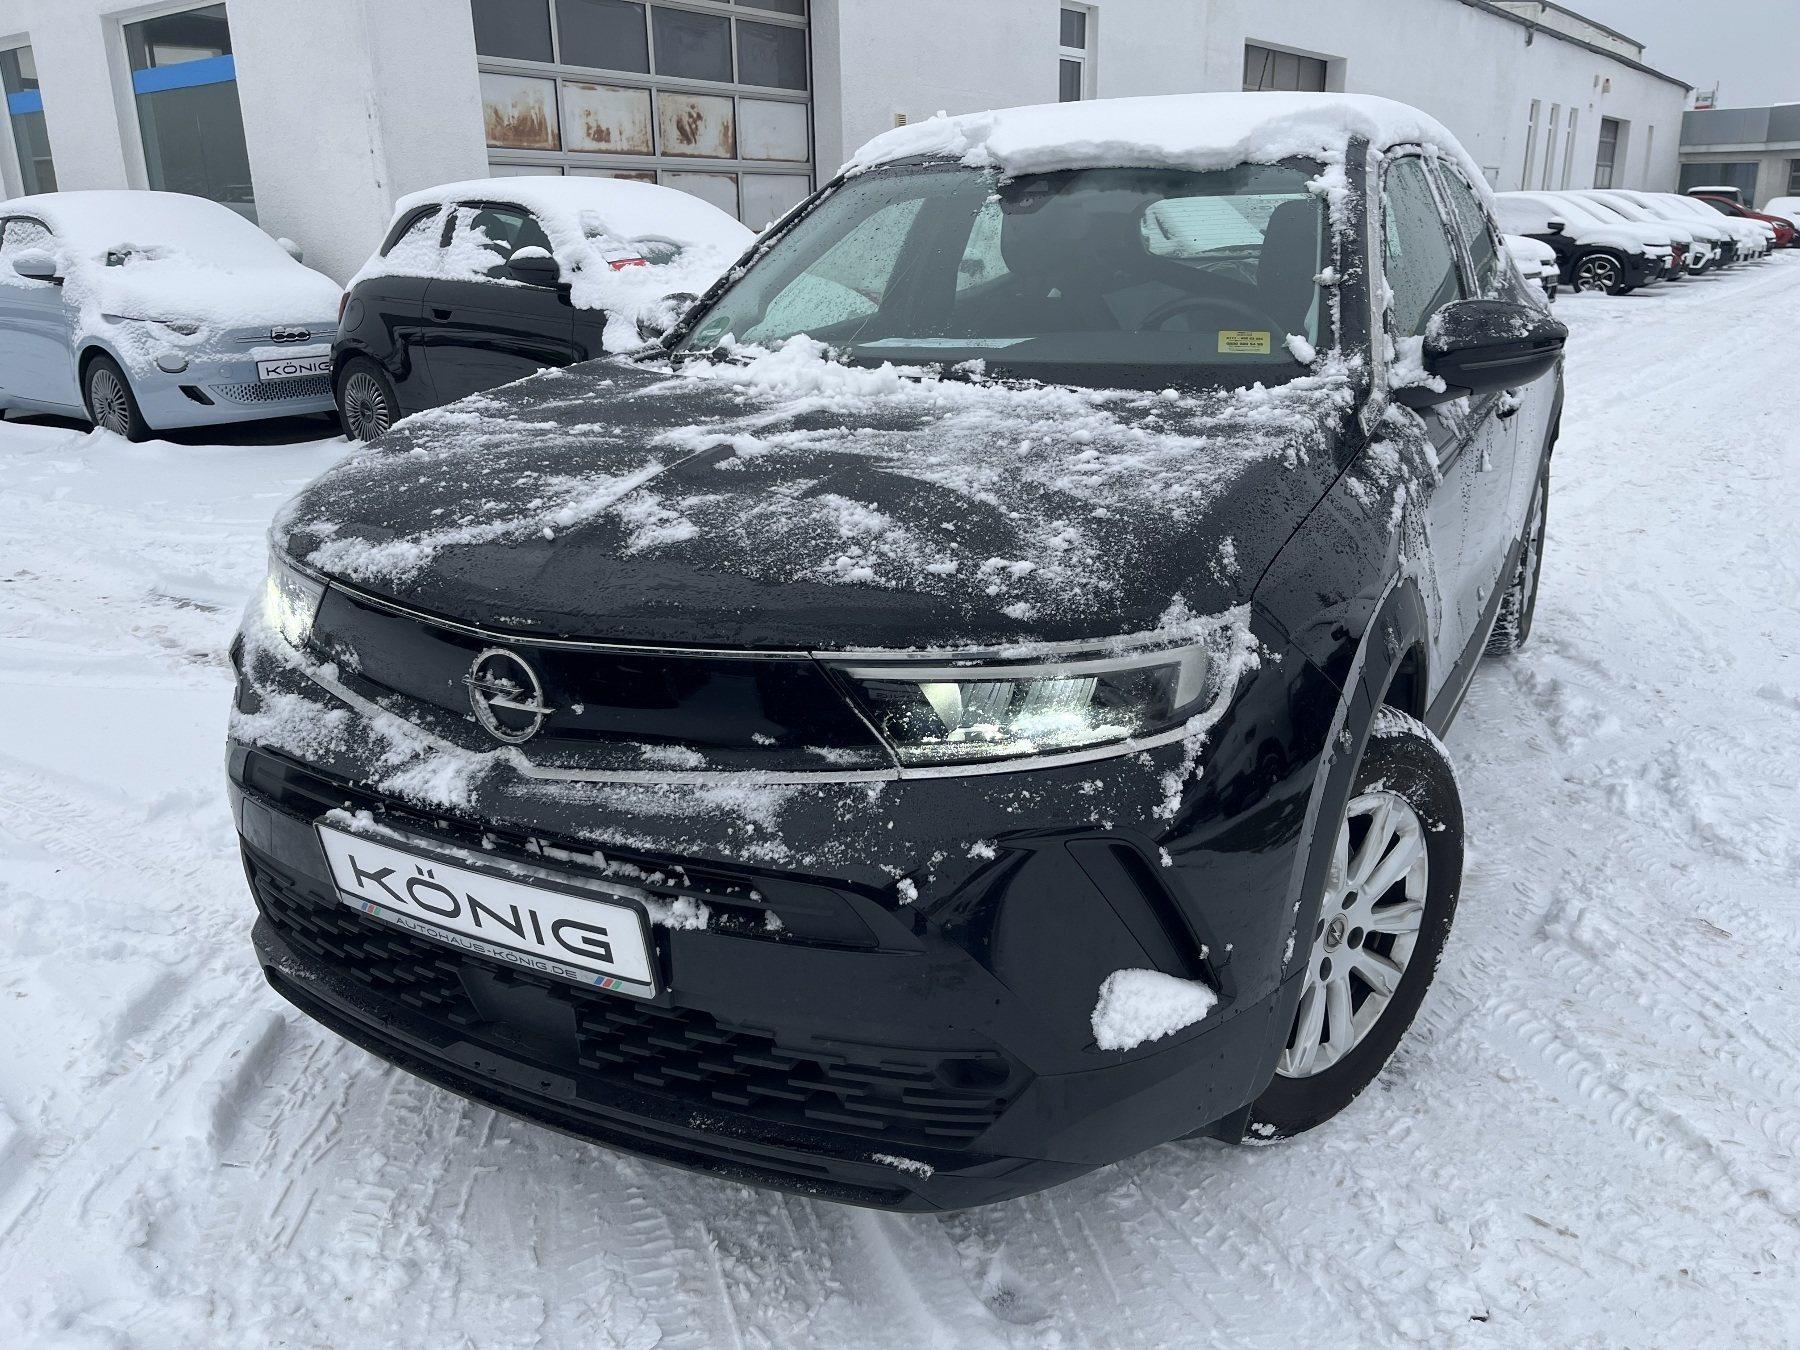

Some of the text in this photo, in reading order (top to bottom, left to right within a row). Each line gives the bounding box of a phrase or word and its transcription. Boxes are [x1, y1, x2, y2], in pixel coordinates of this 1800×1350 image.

[265, 361, 331, 377] KÖNIG
[348, 854, 614, 964] KÖNIG
[396, 916, 578, 979] AUTOHAUS-KÖNIG.DE
